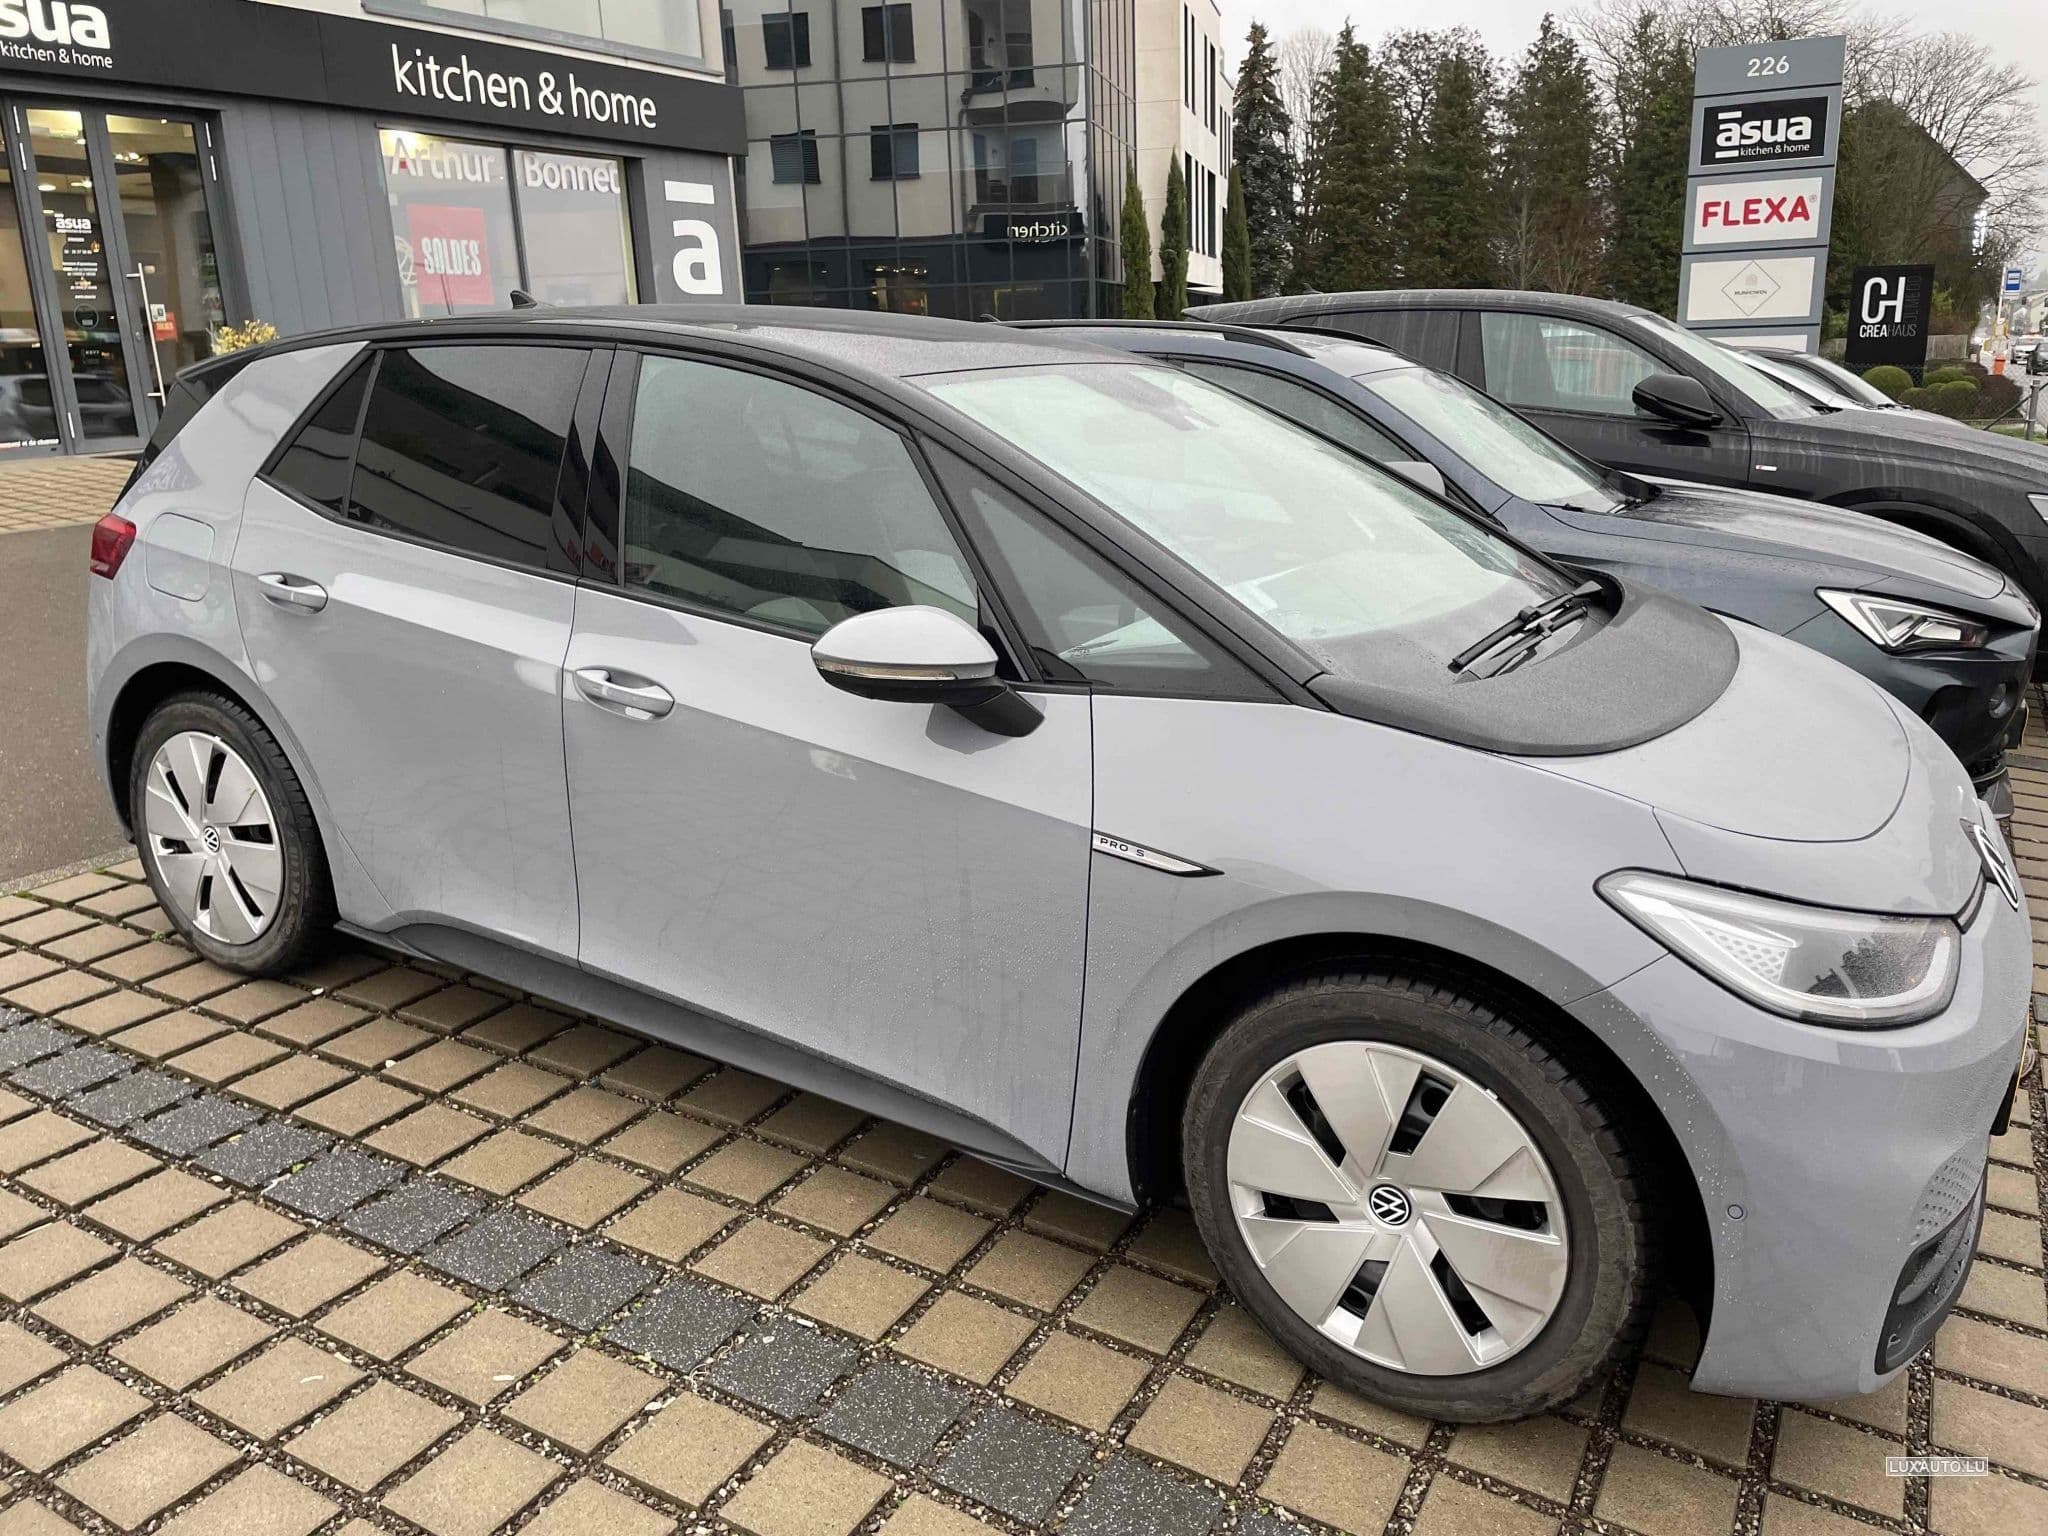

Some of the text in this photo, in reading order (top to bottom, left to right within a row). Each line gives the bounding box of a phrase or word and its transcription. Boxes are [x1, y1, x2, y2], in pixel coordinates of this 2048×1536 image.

[0, 40, 112, 68] kitchen & home
[1747, 55, 1790, 77] 226
[391, 43, 657, 128] kitchen & home
[391, 137, 620, 194] Arthur Bonnet
[1740, 143, 1810, 156] kitchen & home
[421, 237, 482, 276] SOLDES
[1861, 276, 1906, 324] CH
[1100, 837, 1145, 857] PRO S
